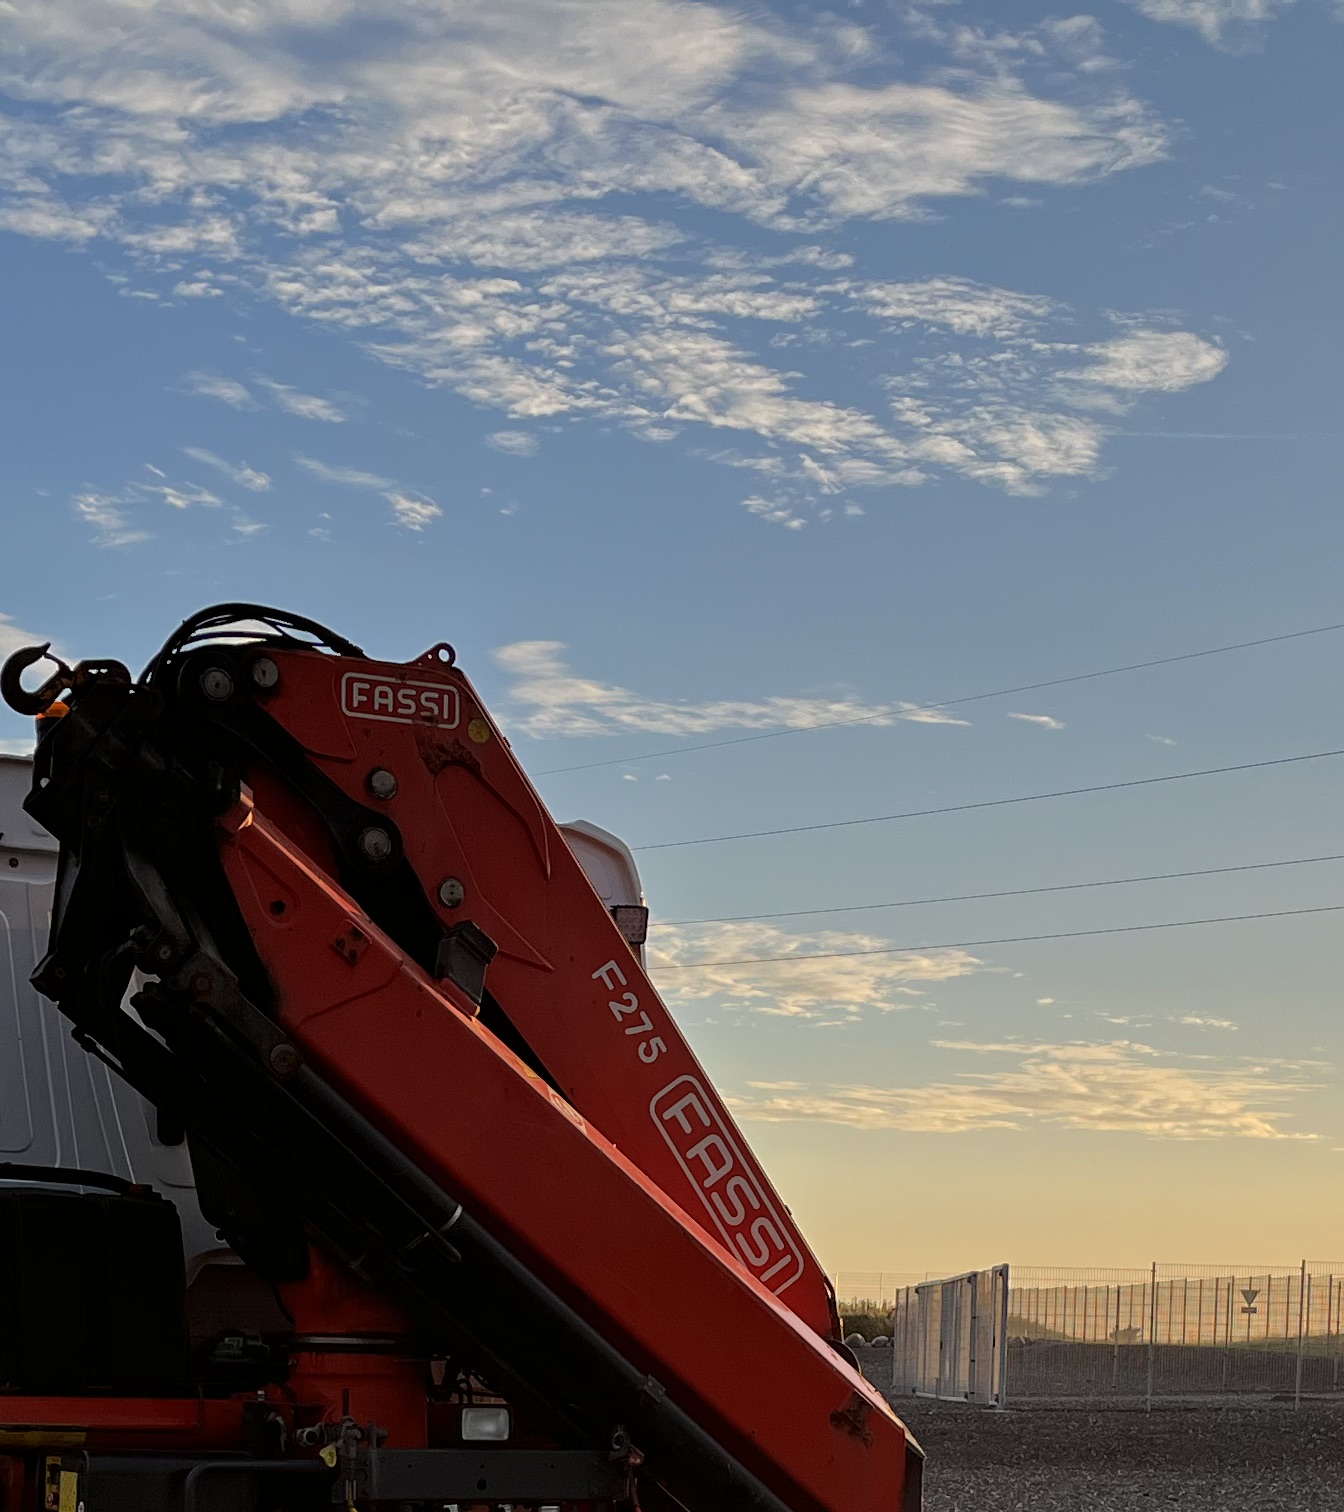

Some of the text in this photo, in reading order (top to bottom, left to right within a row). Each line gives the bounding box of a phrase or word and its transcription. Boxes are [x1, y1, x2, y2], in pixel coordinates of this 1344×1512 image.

[352, 682, 449, 719] FASSI
[591, 959, 667, 1064] F275
[662, 1092, 792, 1282] FASSI
